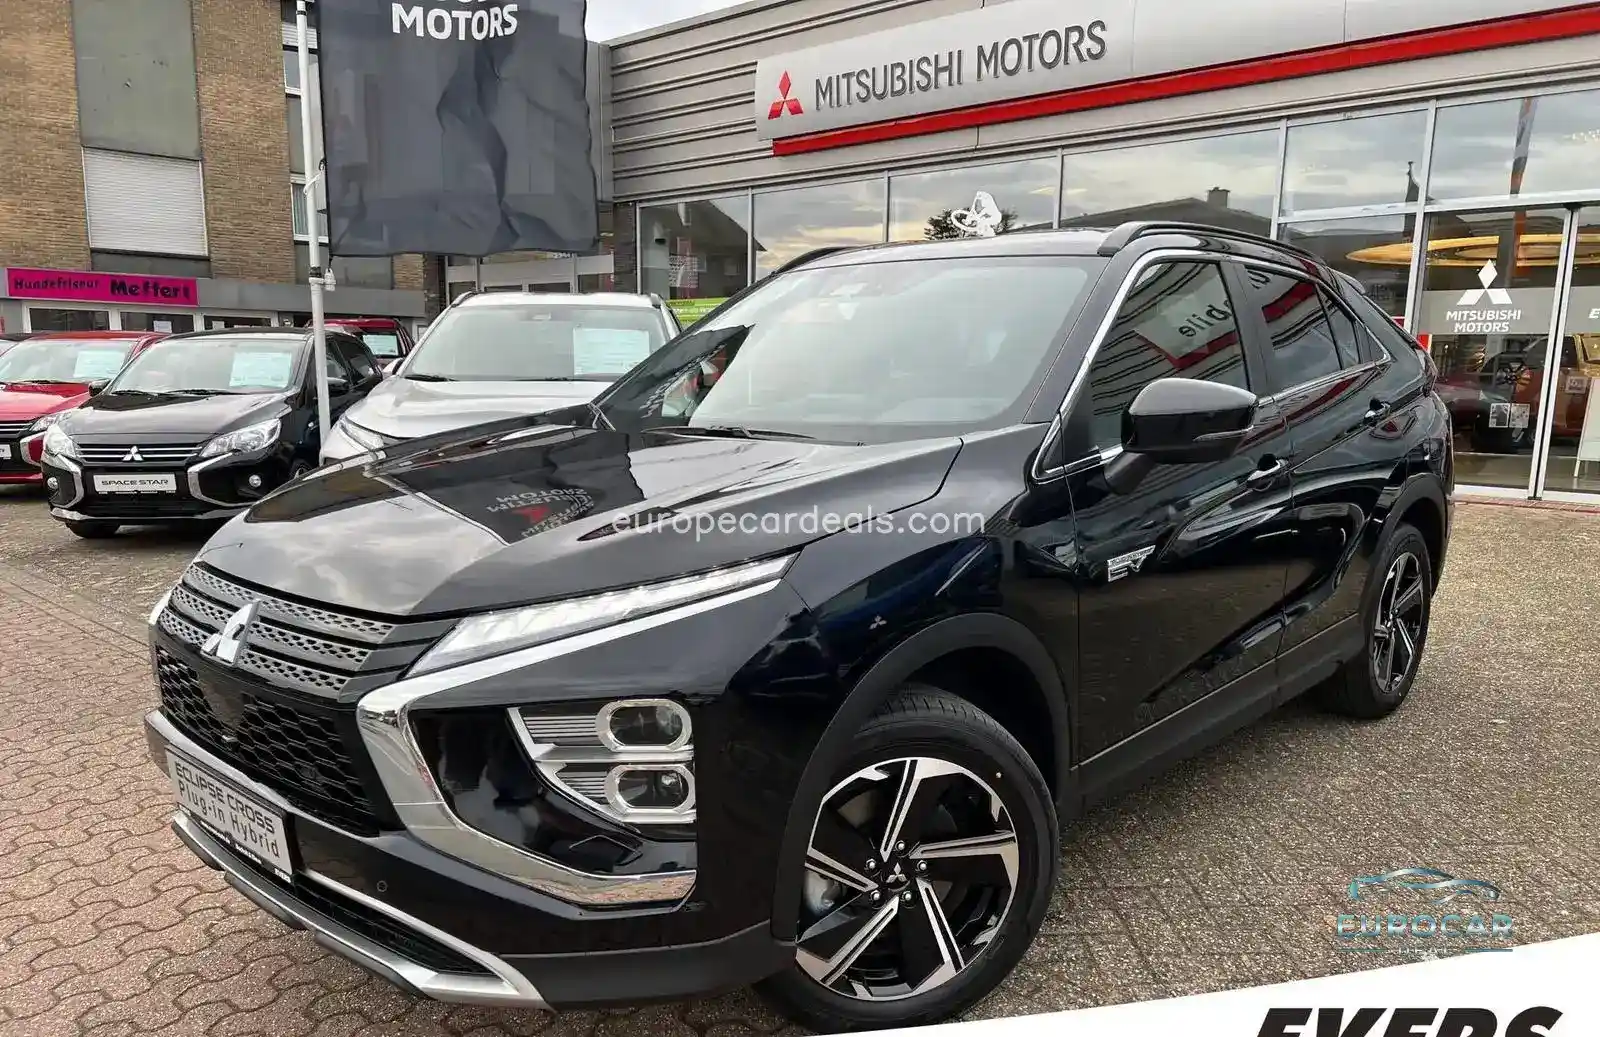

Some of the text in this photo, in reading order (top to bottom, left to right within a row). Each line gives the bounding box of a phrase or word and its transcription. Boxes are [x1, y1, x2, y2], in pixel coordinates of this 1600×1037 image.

[392, 3, 518, 41] MOTORS
[815, 19, 1107, 111] MITSUBISHI MOTORS
[1446, 309, 1522, 321] MITSUBISHI
[1454, 322, 1510, 333] MOTORS
[175, 761, 225, 804] ECLIPSE
[227, 793, 275, 834] CROSS
[178, 780, 226, 824] Plug-in
[230, 812, 280, 858] Hybrid
